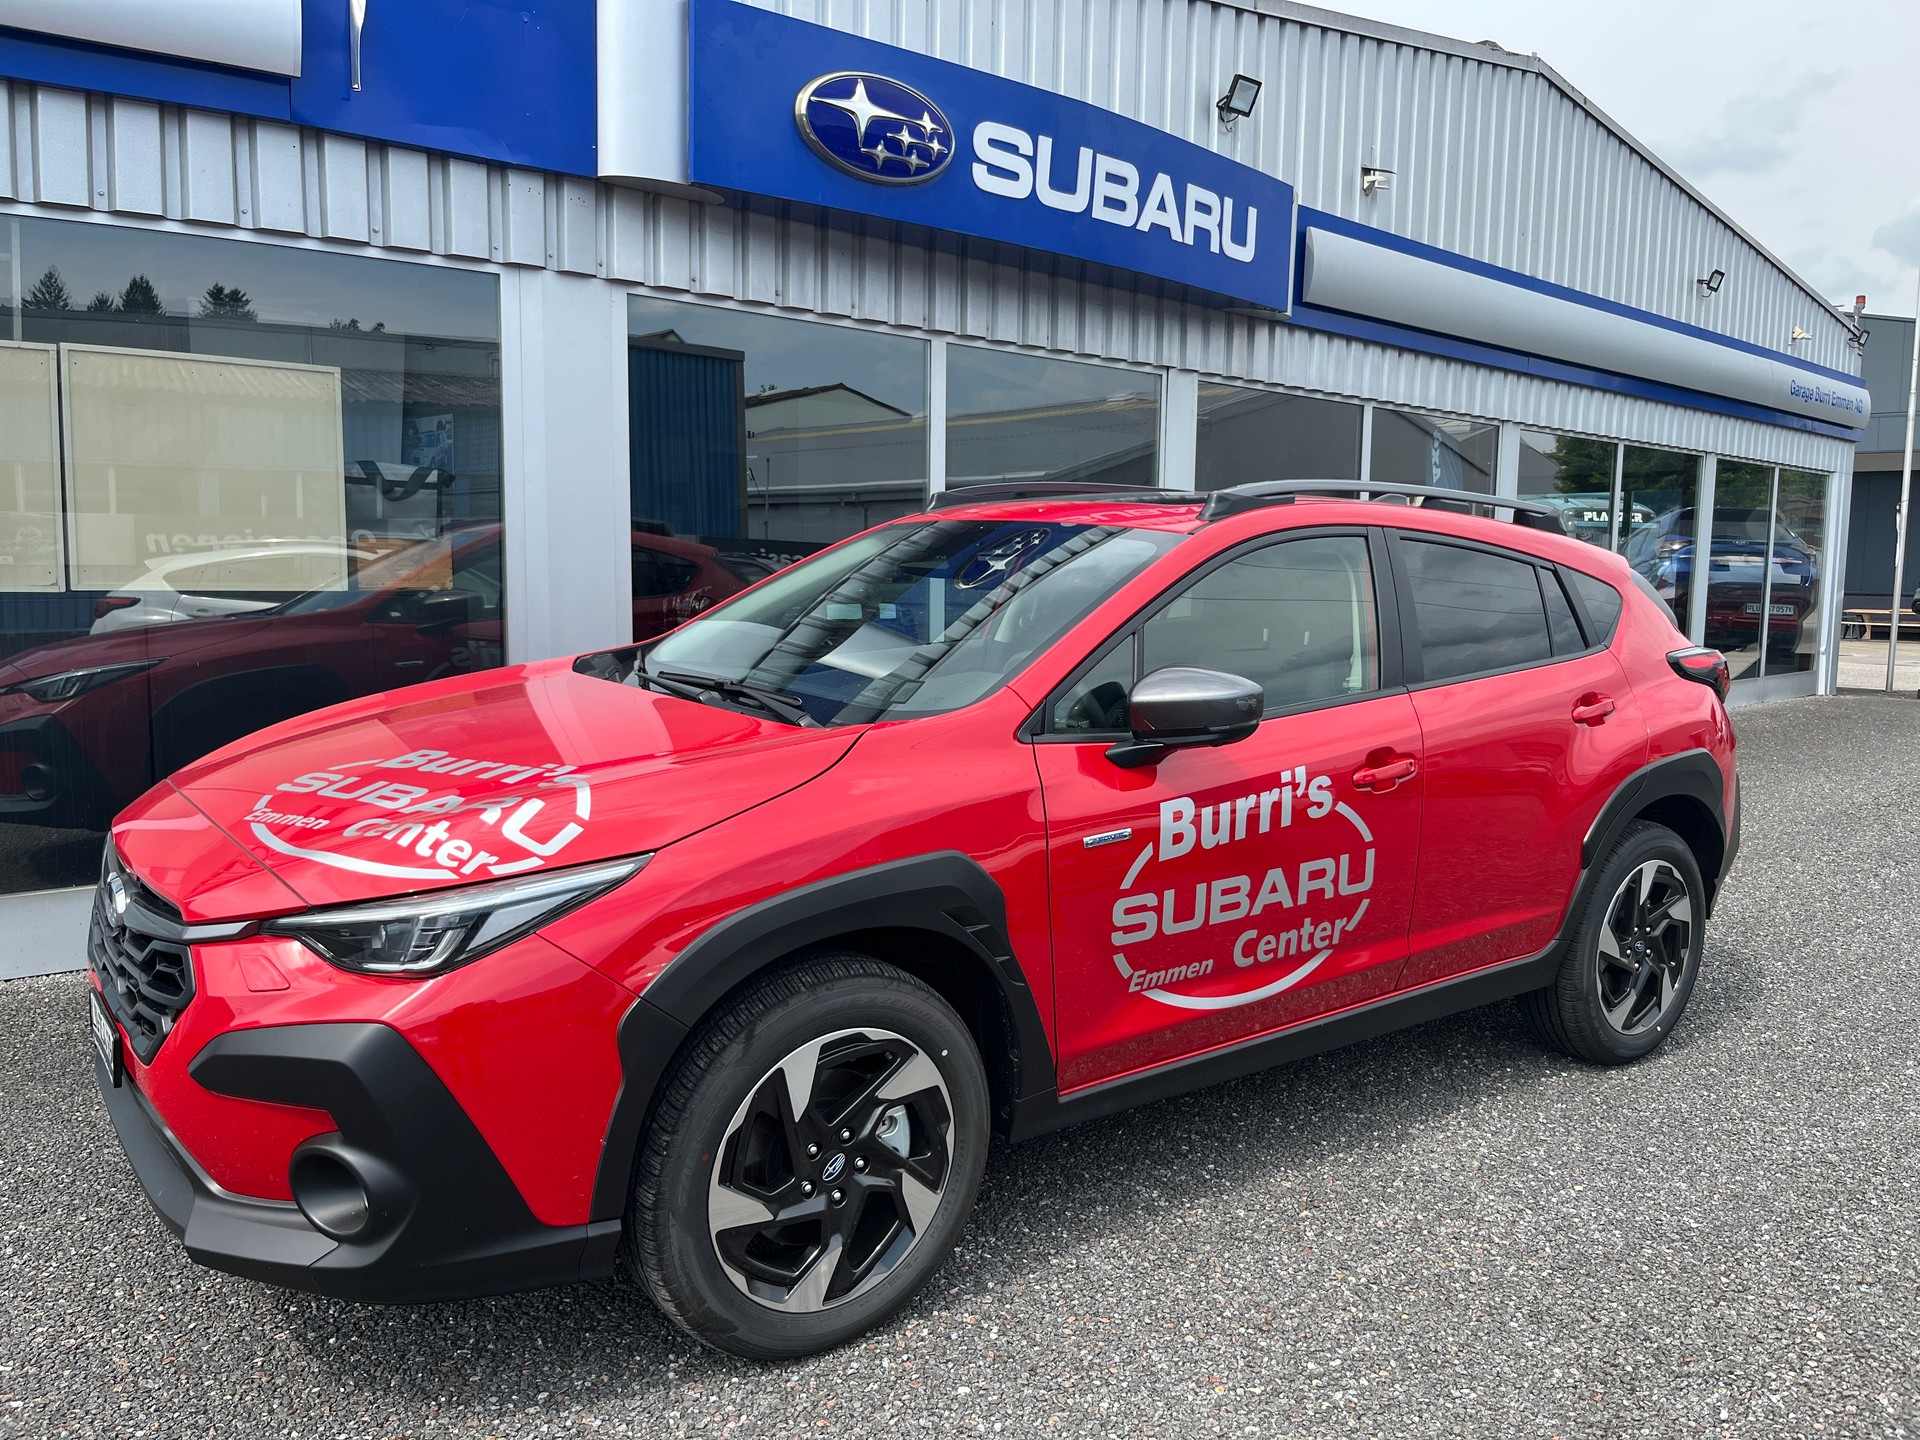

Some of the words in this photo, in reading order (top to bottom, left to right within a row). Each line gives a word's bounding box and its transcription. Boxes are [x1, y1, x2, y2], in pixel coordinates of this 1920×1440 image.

[972, 121, 1257, 263] SUBARU
[1790, 379, 1814, 403] Garage
[1814, 386, 1831, 405] Burri
[1831, 391, 1854, 411] Emmen
[1853, 397, 1863, 413] AG
[1583, 511, 1643, 523] PLAR
[375, 749, 592, 788] Burri's
[243, 807, 331, 830] Emmen
[342, 817, 500, 876] Center
[276, 771, 585, 857] SUBARU
[1158, 765, 1334, 863] Burri's
[1110, 848, 1376, 947] SUBARU
[1128, 957, 1214, 993] Emmen
[1232, 917, 1348, 969] Center
